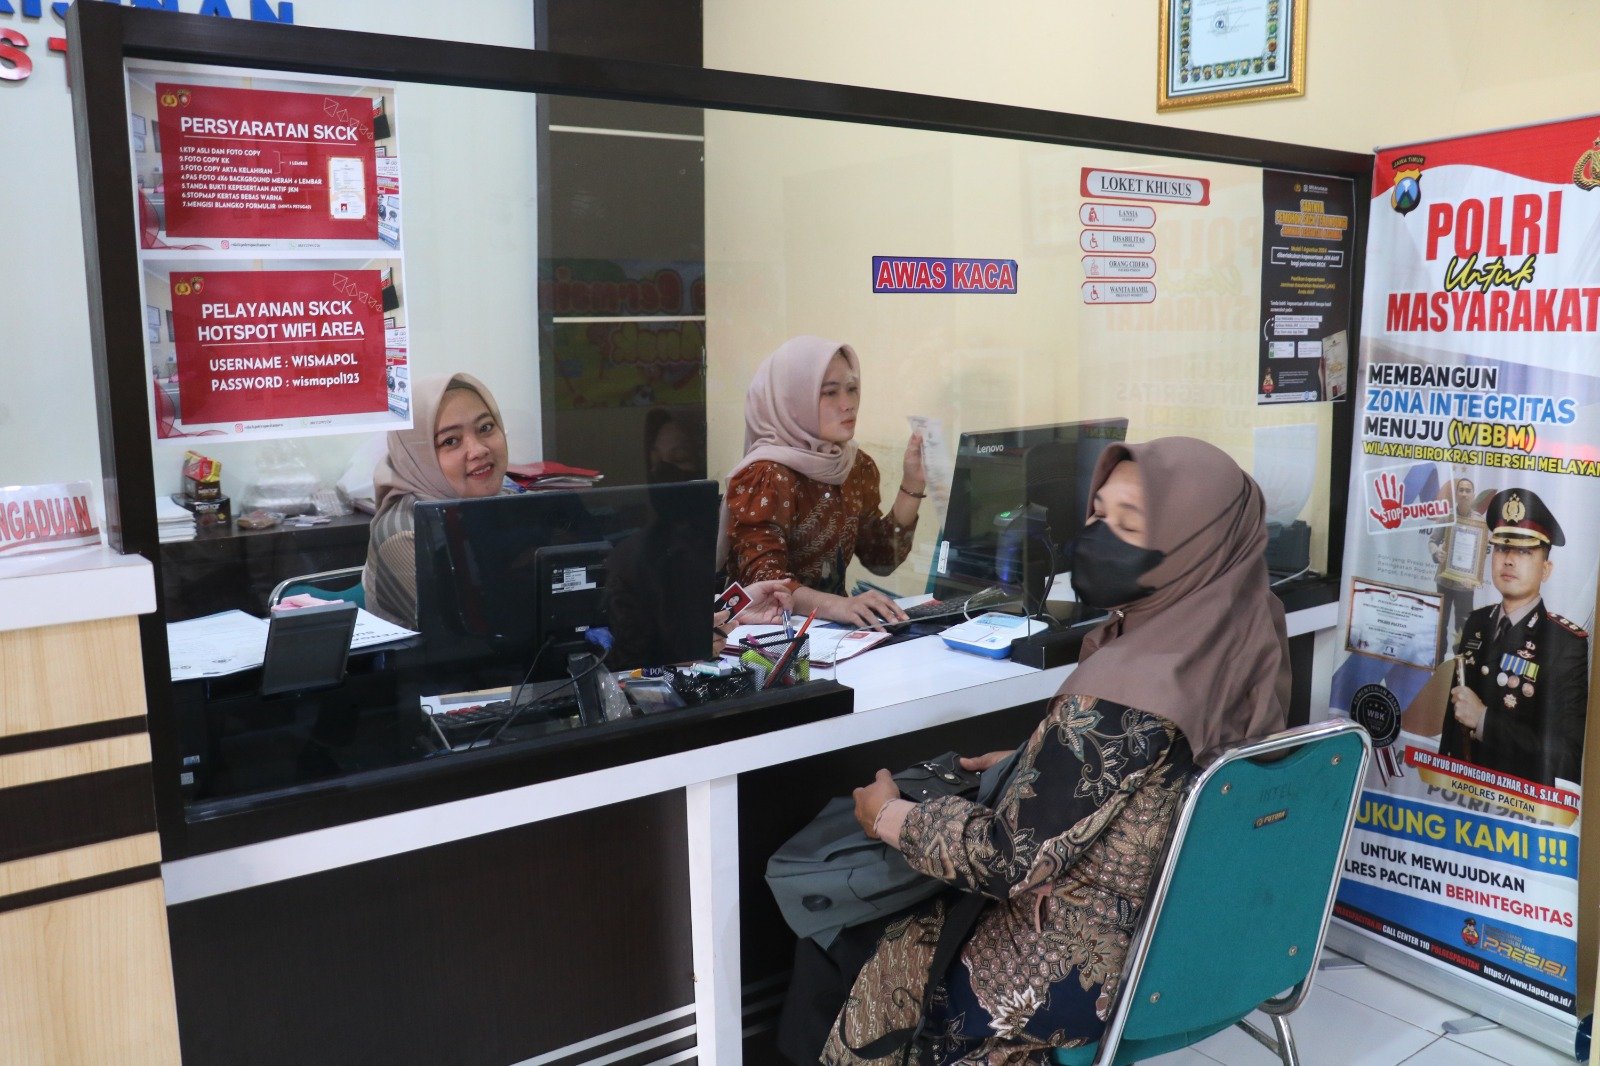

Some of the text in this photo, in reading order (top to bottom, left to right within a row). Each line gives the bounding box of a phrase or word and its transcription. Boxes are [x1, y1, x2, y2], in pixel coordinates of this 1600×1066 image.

[180, 116, 358, 141] PERSYARATAN SKCK
[239, 167, 273, 175] KELAHIRAN
[1101, 176, 1192, 196] LOKET KHUSUS
[246, 202, 276, 210] FORMULIR
[1426, 190, 1562, 261] POLRI
[876, 260, 1014, 290] AWAS KACA
[1444, 252, 1537, 294] Untuk
[202, 300, 352, 319] PELAYANAN SKCK
[1386, 288, 1600, 333] MASYARAKAT
[198, 320, 365, 342] HOTSPOT WIFI AREA
[209, 356, 282, 372] USERNAME
[291, 353, 358, 368] WISMAPOL
[1368, 364, 1498, 389] MEMBANGUN
[211, 376, 283, 391] PASSWORD
[292, 372, 360, 388] wismapol123
[1366, 389, 1576, 424] ZONA INTEGRITAS
[976, 443, 1004, 454] Lenovo
[1364, 416, 1536, 454] MENUJU (WBBM)
[1362, 440, 1413, 459] WILAYAH
[1413, 446, 1484, 466] BIROKRASI
[1485, 452, 1536, 471] BERSIH
[1382, 500, 1449, 523] STOP PUNGLI
[1367, 708, 1385, 721] WBK
[1413, 751, 1432, 765] AKBP
[1431, 755, 1450, 769] AYUB
[1451, 760, 1495, 784] DIPONEGORO
[1496, 774, 1523, 794] AZHAR,
[1451, 780, 1535, 814] KAPOLRES PACITAN
[1455, 819, 1528, 859] KAMI
[1538, 837, 1568, 867] !!!
[1361, 842, 1525, 893] UNTUK MEWUJUDKAN
[1344, 859, 1574, 928] LRES PACITAN BERINTEGRITAS
[1382, 924, 1396, 937] CALL
[1396, 930, 1419, 946] CENTER
[1419, 940, 1430, 950] 110
[1483, 965, 1572, 1007] https://www.lapor.go.id/
[1483, 936, 1568, 977] PRESISI
